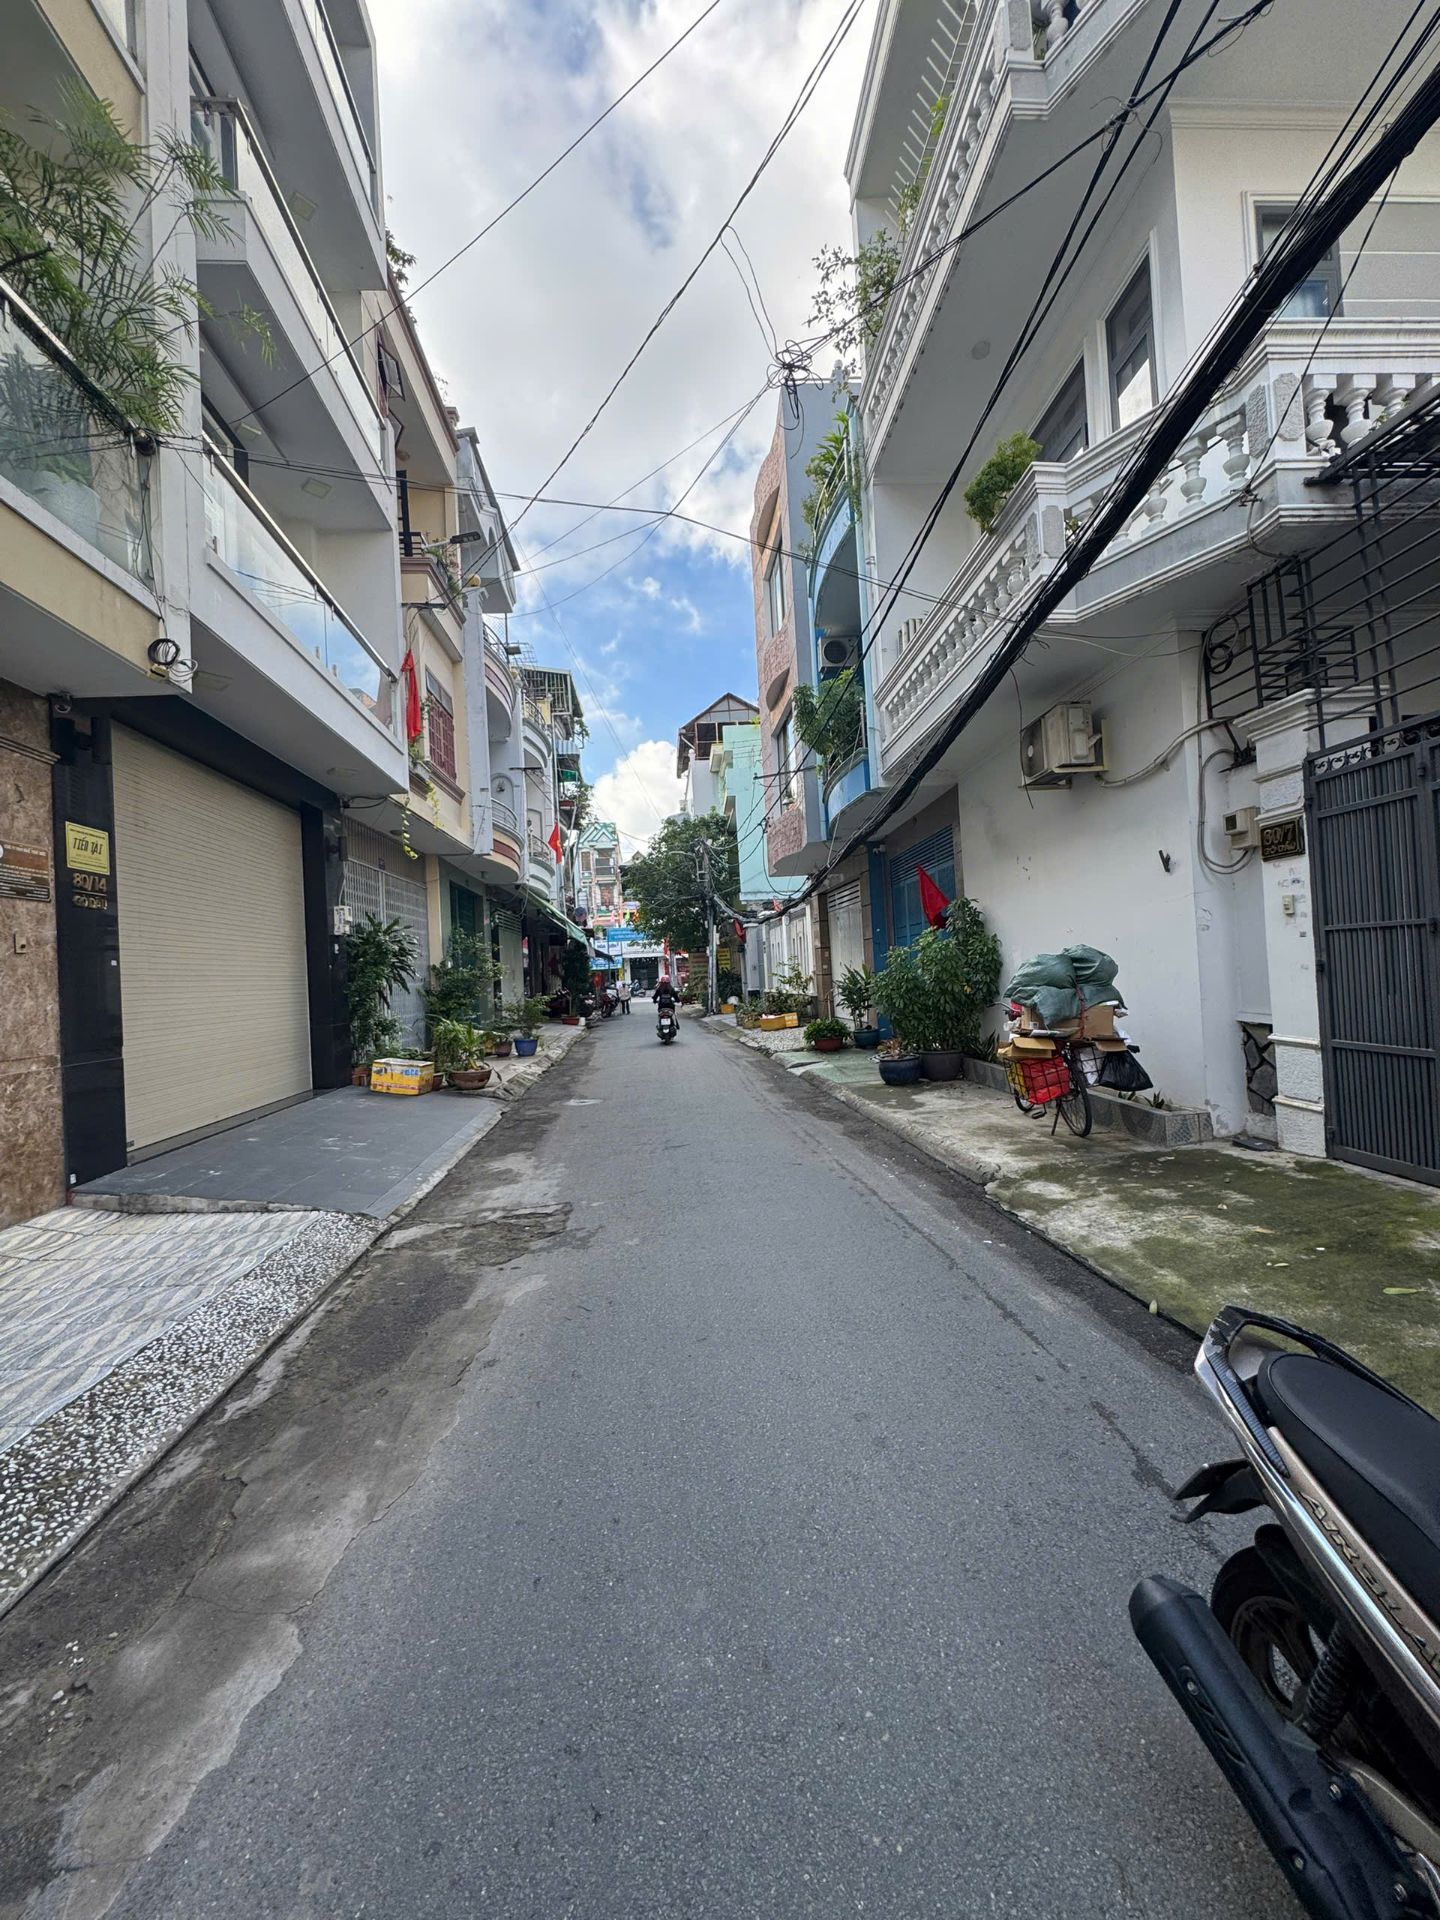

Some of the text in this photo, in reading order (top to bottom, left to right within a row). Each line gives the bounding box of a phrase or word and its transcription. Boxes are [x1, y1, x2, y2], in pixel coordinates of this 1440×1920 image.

[1264, 823, 1295, 845] 80/7
[72, 872, 107, 892] 80/14
[1298, 1490, 1361, 1564] AIR
